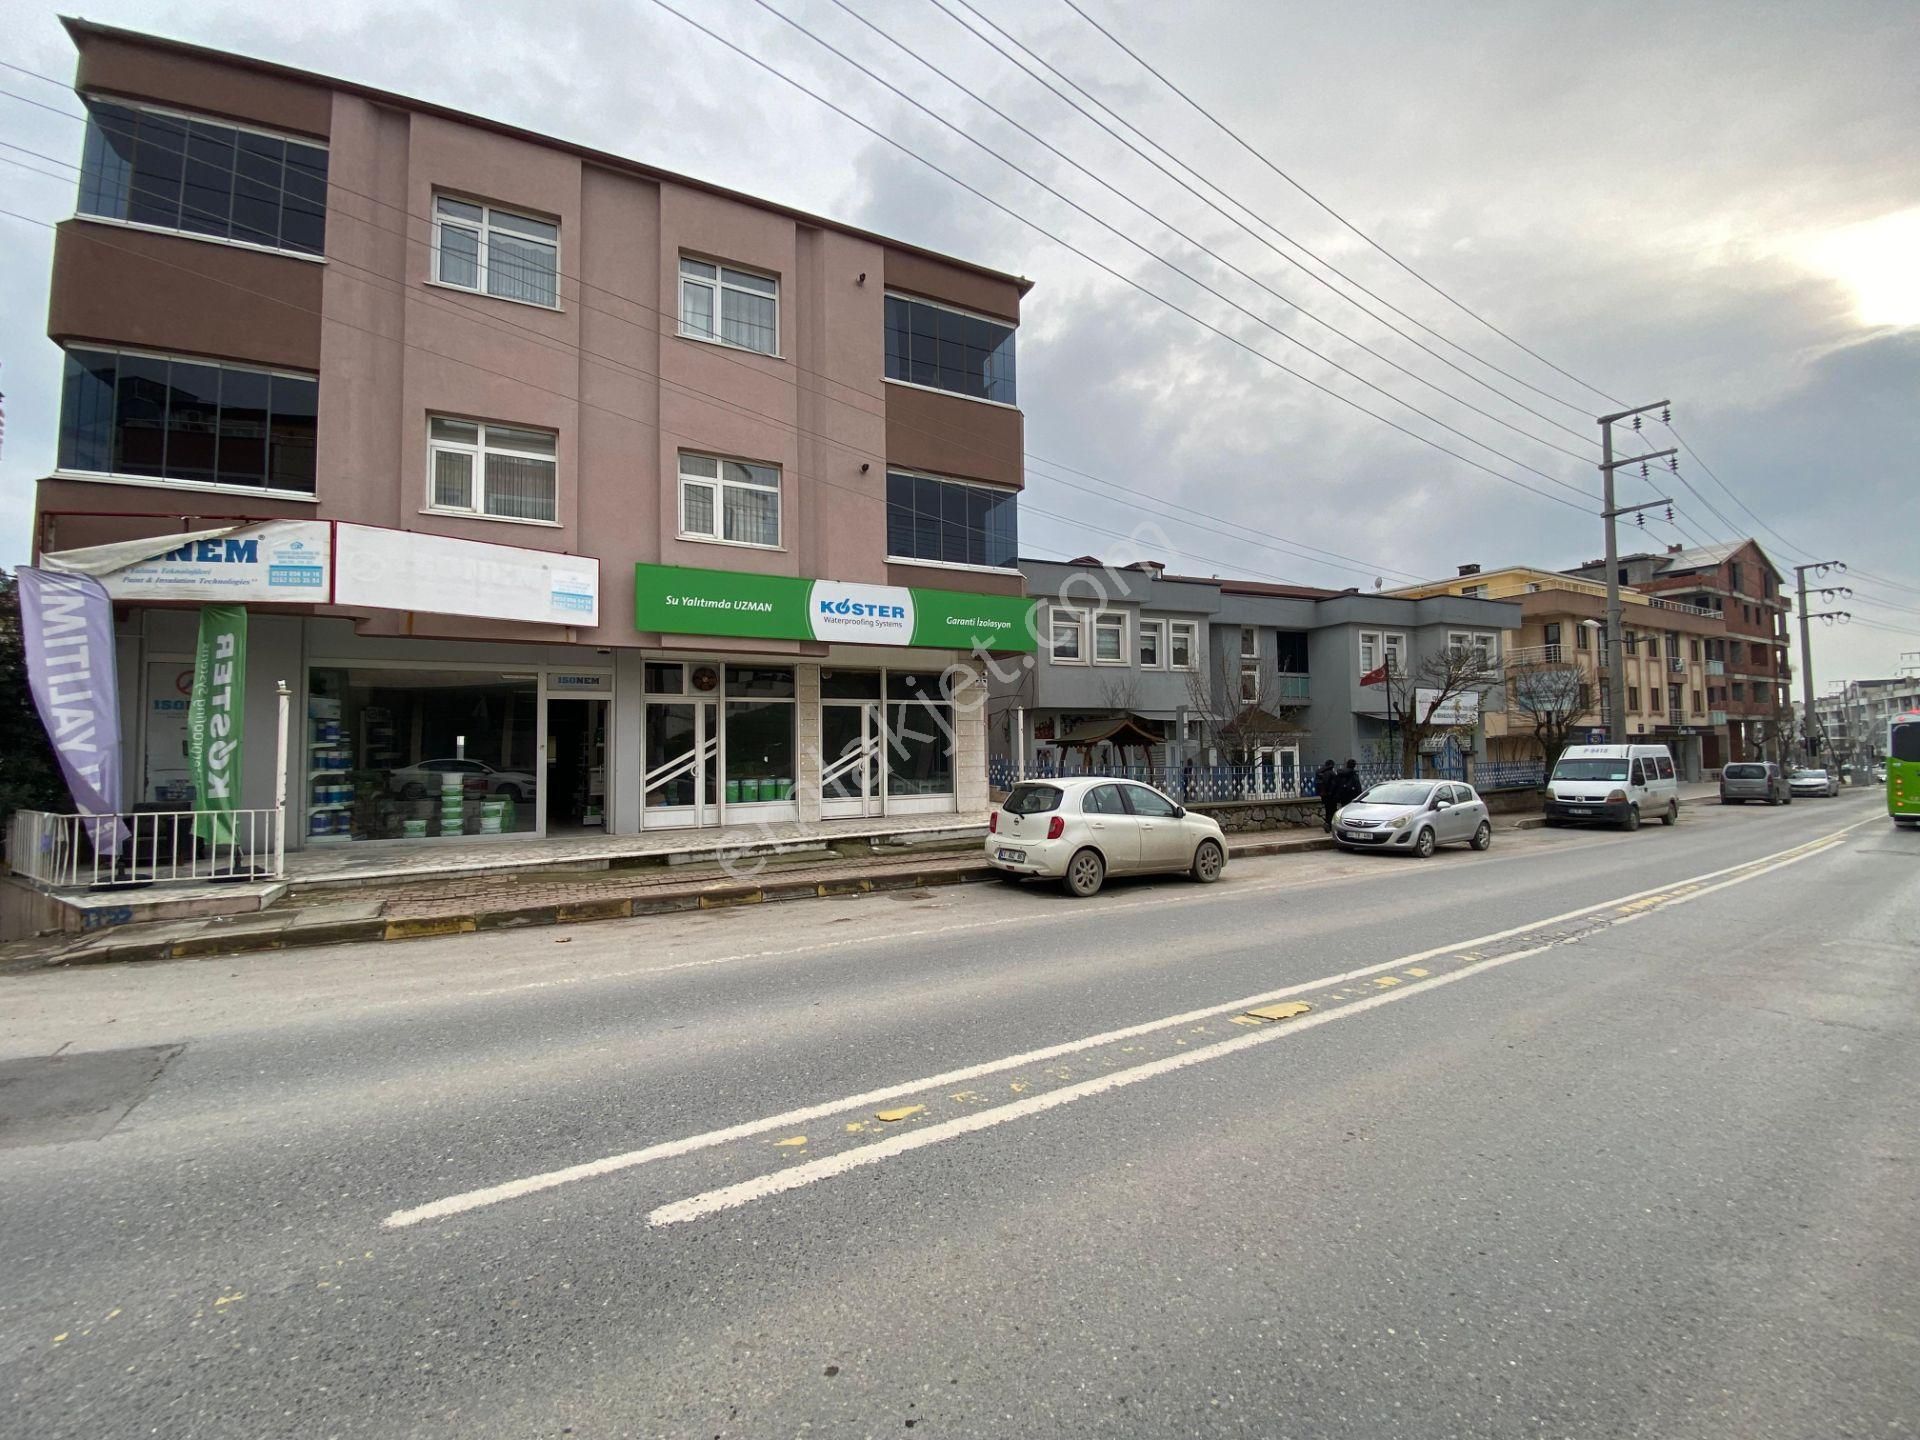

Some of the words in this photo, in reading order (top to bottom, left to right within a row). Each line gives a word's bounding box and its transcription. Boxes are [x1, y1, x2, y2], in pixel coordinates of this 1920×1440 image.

[146, 539, 259, 564] NEM
[665, 595, 679, 606] Su
[681, 596, 731, 609] Yalıtımda
[733, 600, 772, 612] UZMAN
[823, 616, 874, 628] Waterproofing
[875, 619, 903, 629] Systems
[946, 616, 975, 626] Garanti
[977, 617, 1011, 630] İzolasyon
[559, 676, 600, 685] ISONEM
